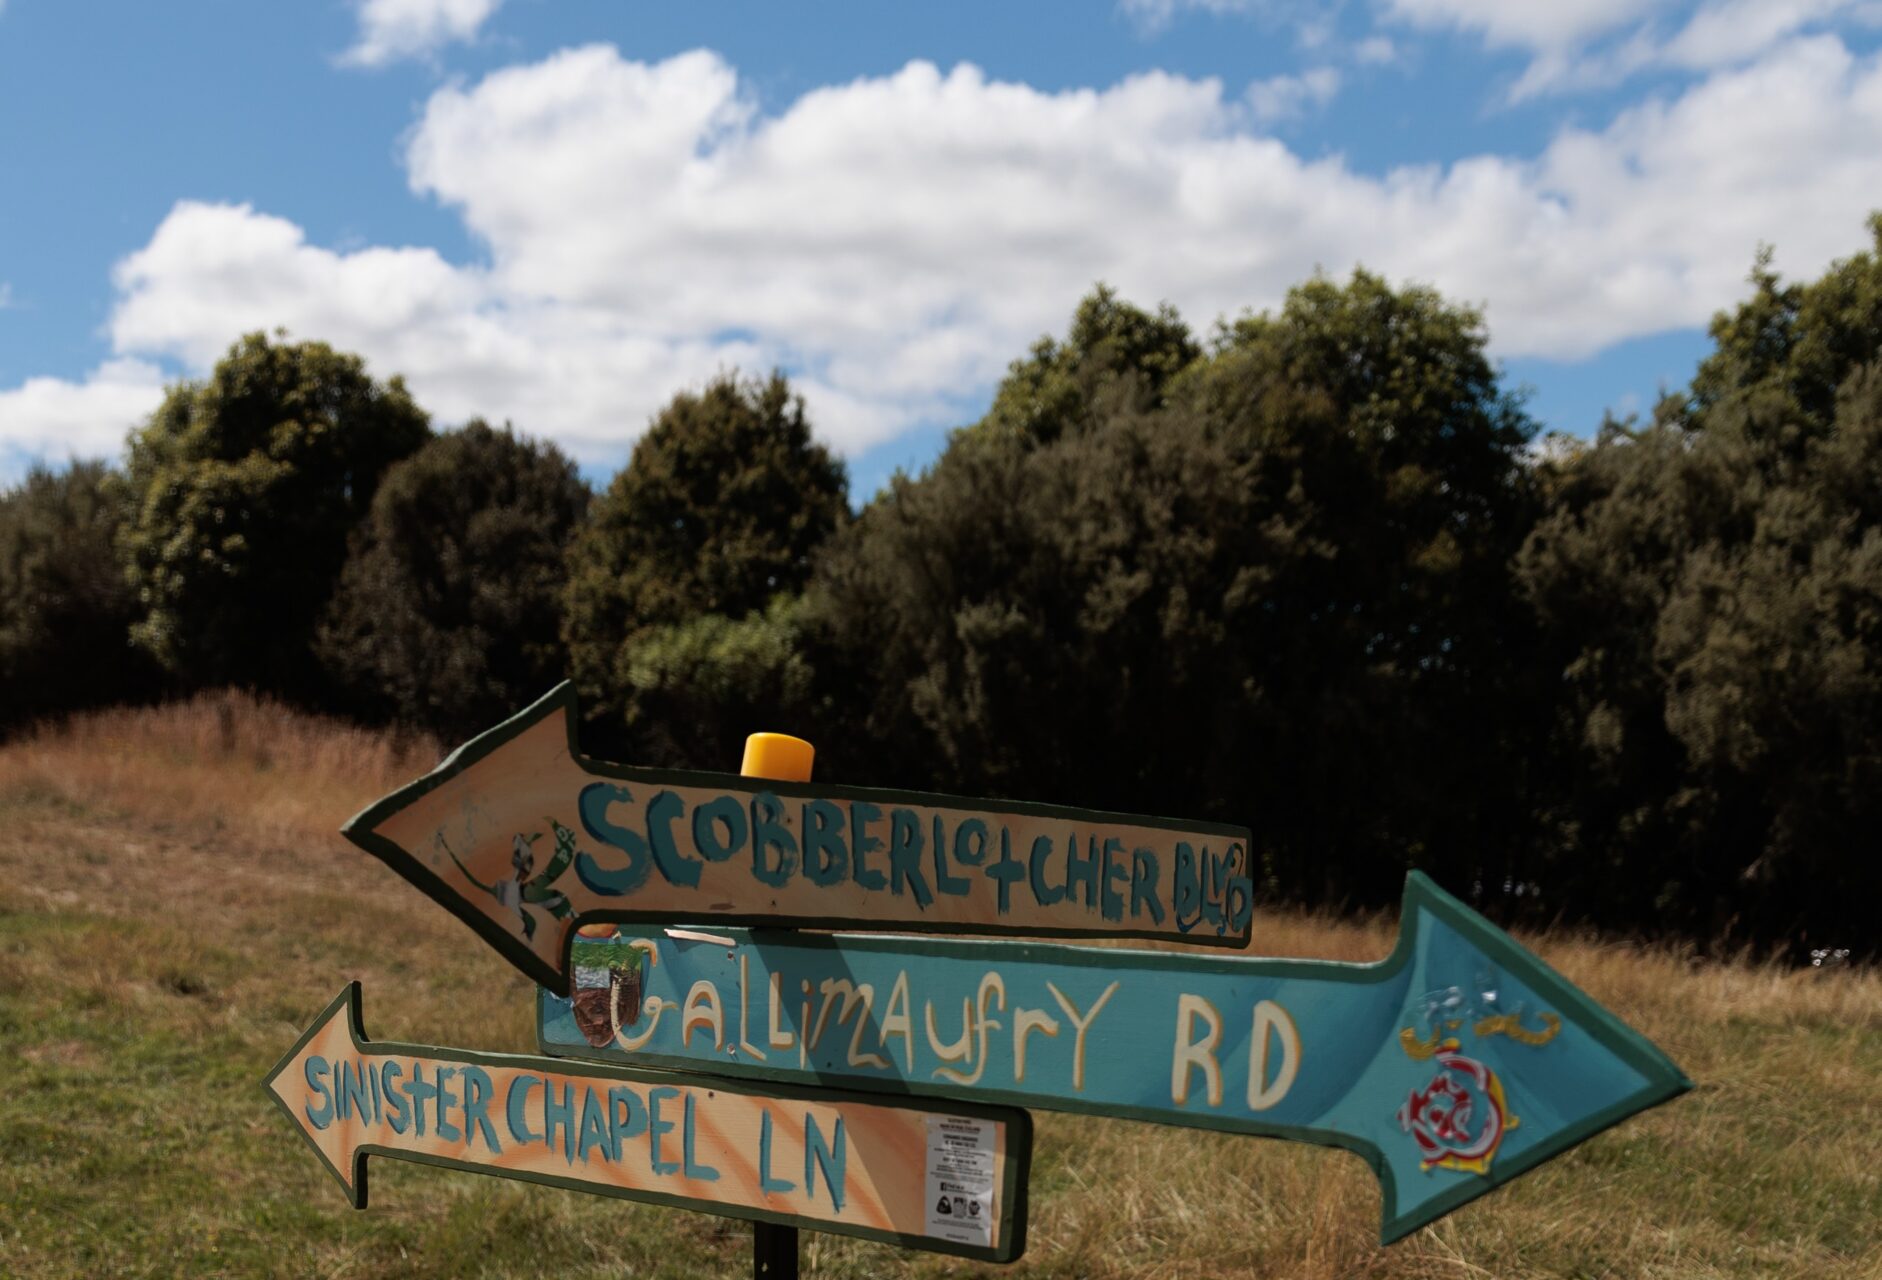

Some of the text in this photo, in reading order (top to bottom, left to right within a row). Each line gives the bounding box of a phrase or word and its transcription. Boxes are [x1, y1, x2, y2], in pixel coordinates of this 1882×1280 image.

[1171, 993, 1302, 1112] RD
[506, 1072, 721, 1182] CHAPEL
[759, 1107, 846, 1215] LN
